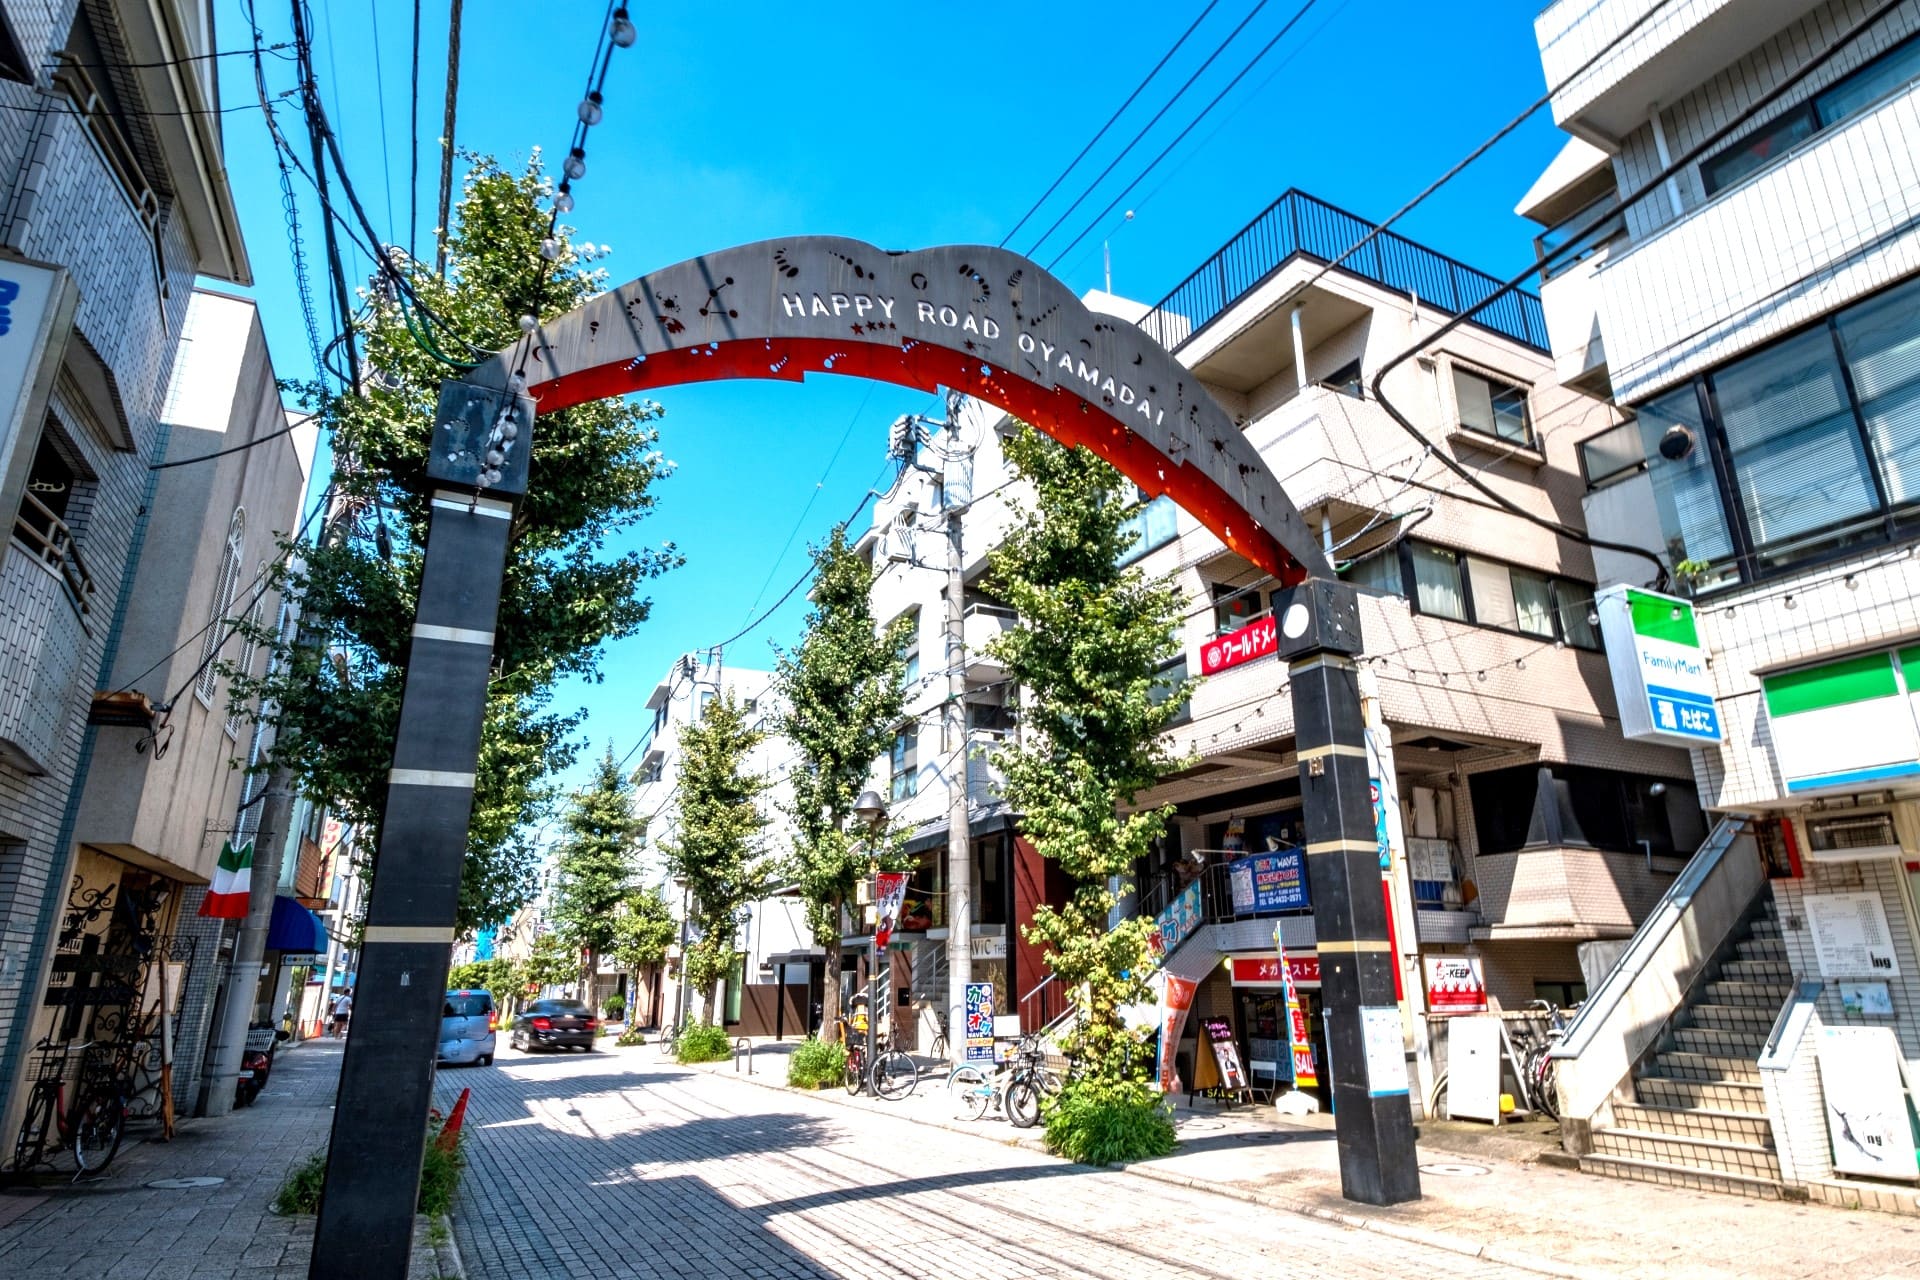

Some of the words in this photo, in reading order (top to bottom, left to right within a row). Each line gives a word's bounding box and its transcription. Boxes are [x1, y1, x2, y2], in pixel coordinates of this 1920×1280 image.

[781, 293, 895, 318] HAPPY
[917, 300, 1001, 340] ROAD
[1017, 331, 1165, 426] OYAMADAI
[1642, 651, 1702, 677] FamilyMart
[1681, 707, 1713, 732] たばこ
[1260, 963, 1320, 977] メガストア
